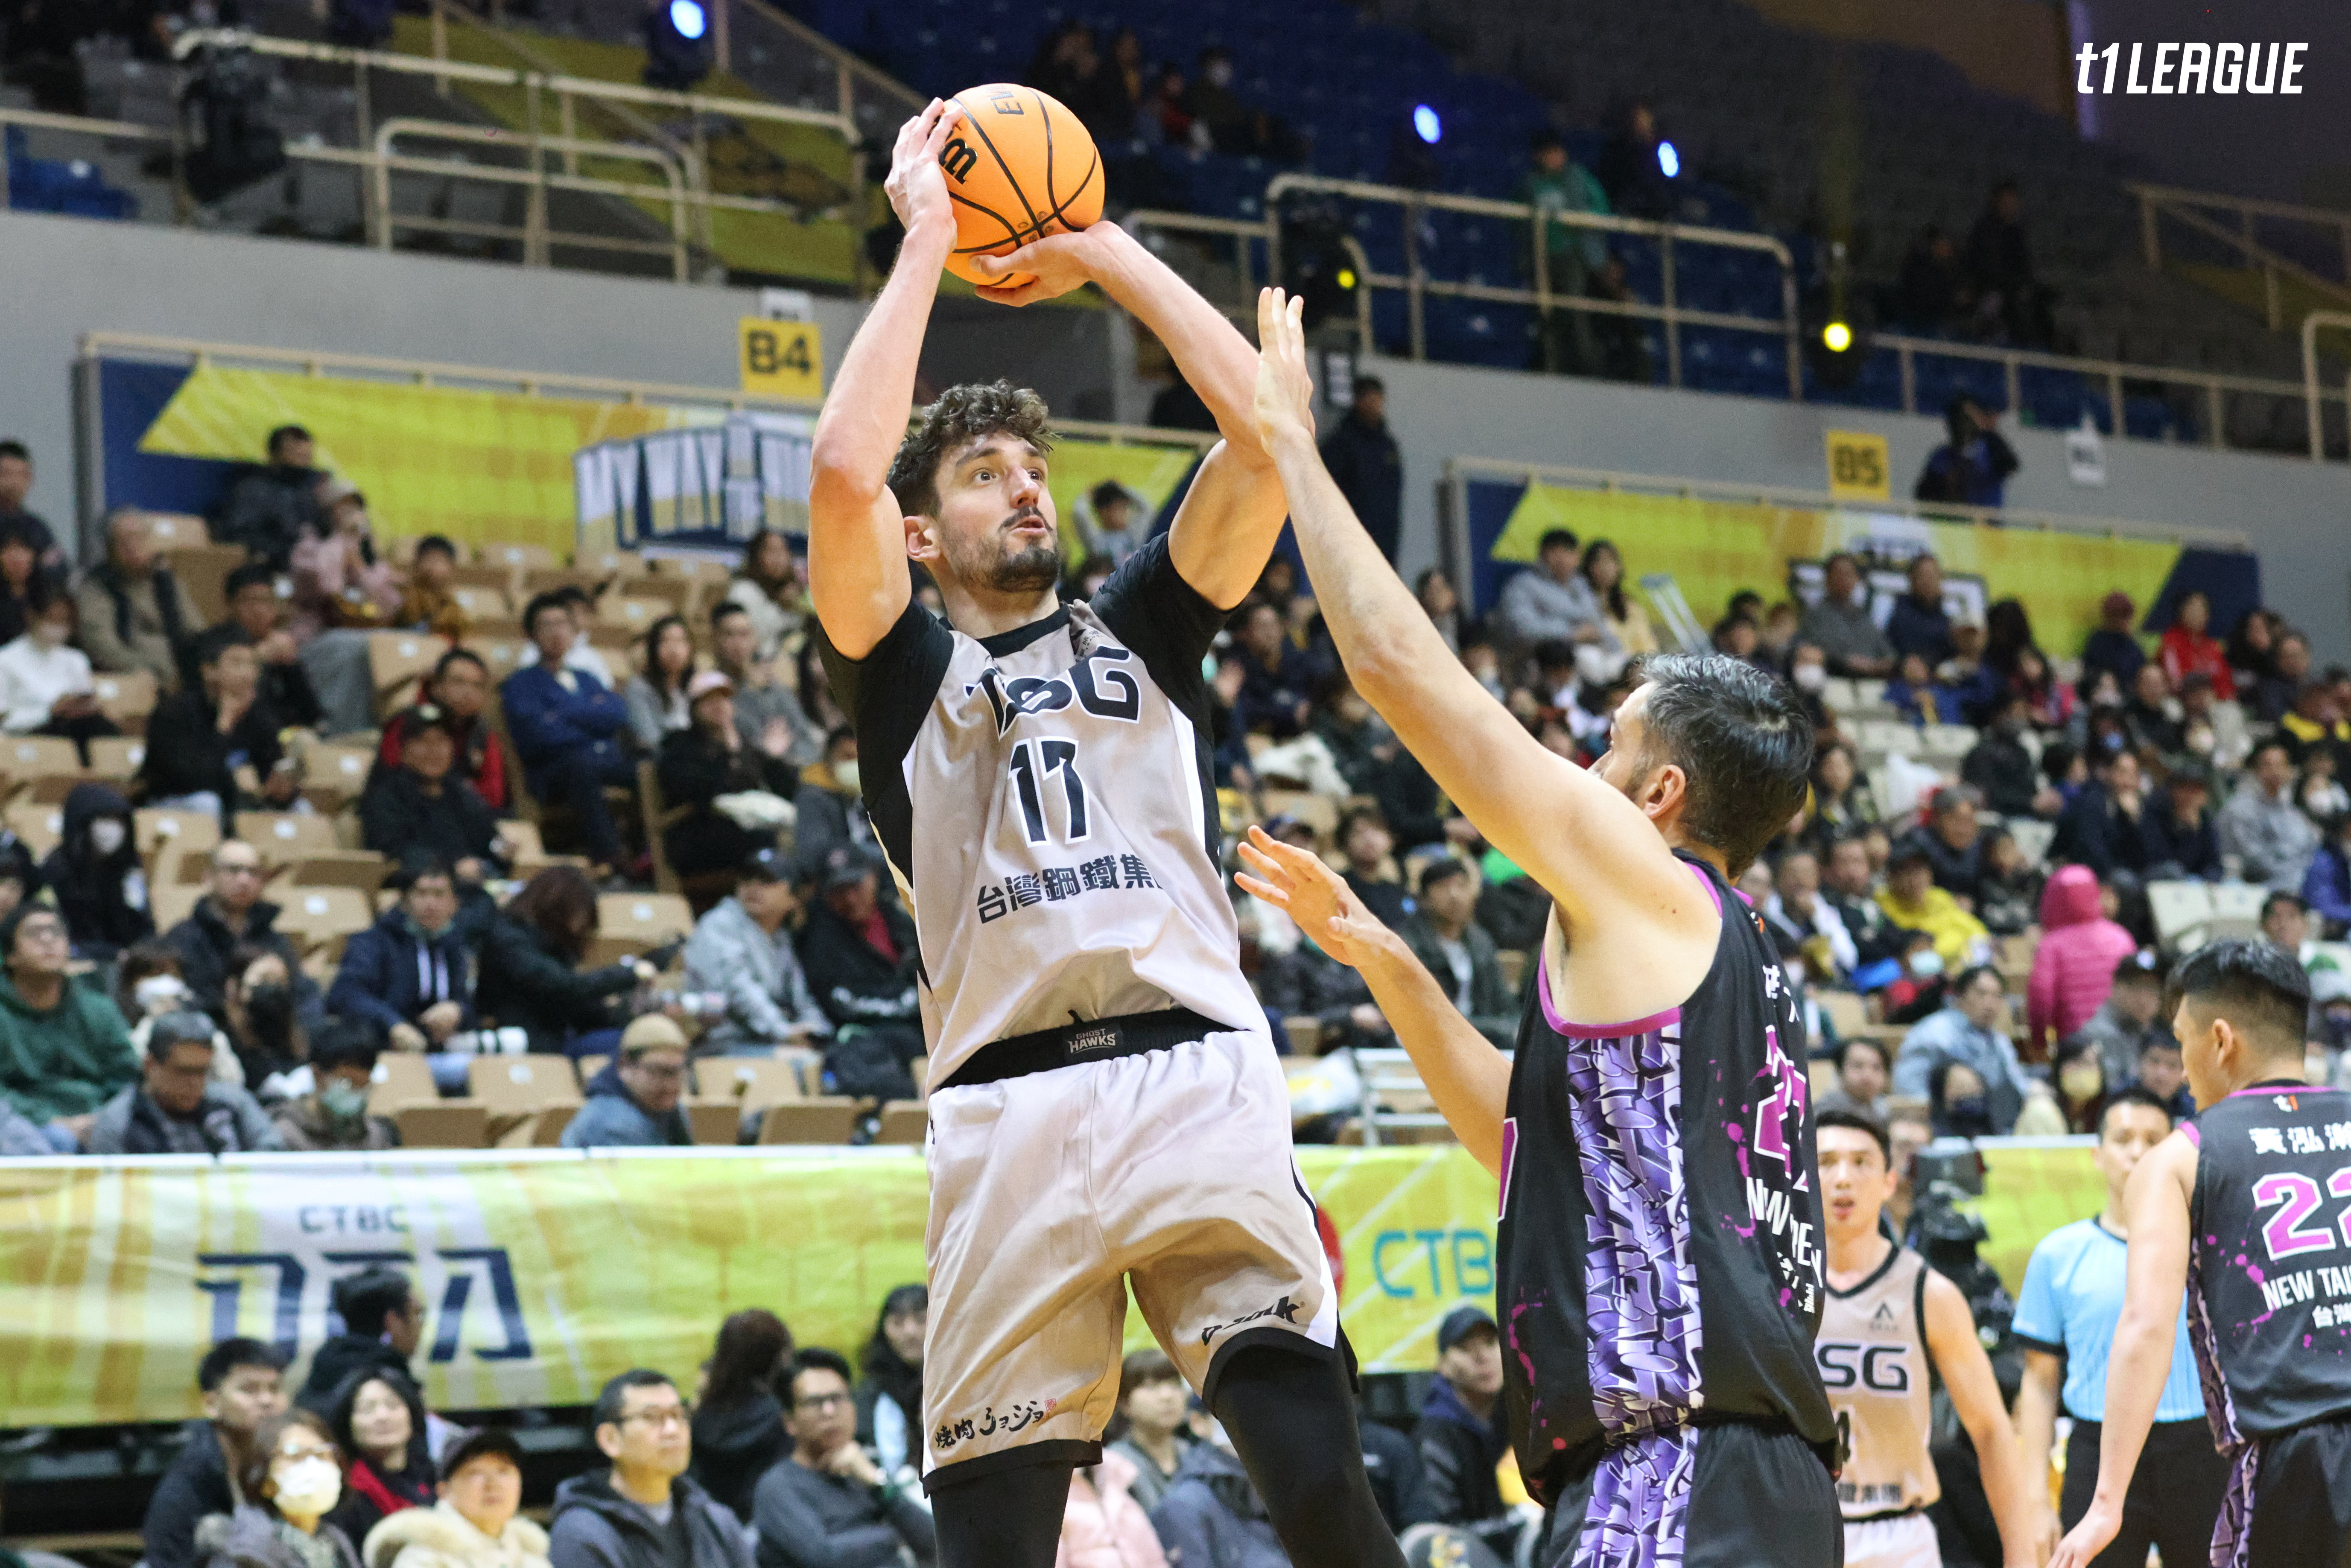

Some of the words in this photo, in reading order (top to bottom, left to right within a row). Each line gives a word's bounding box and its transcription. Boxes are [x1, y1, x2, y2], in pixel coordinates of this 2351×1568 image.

[747, 329, 812, 375] B4
[1008, 735, 1092, 848] 17
[977, 853, 1164, 924] 台灣鋼鐵集
[1068, 1033, 1116, 1053] HAWKS
[1076, 1028, 1106, 1039] GHOST
[298, 1205, 410, 1233] CTBC
[2261, 1270, 2315, 1311] NEW
